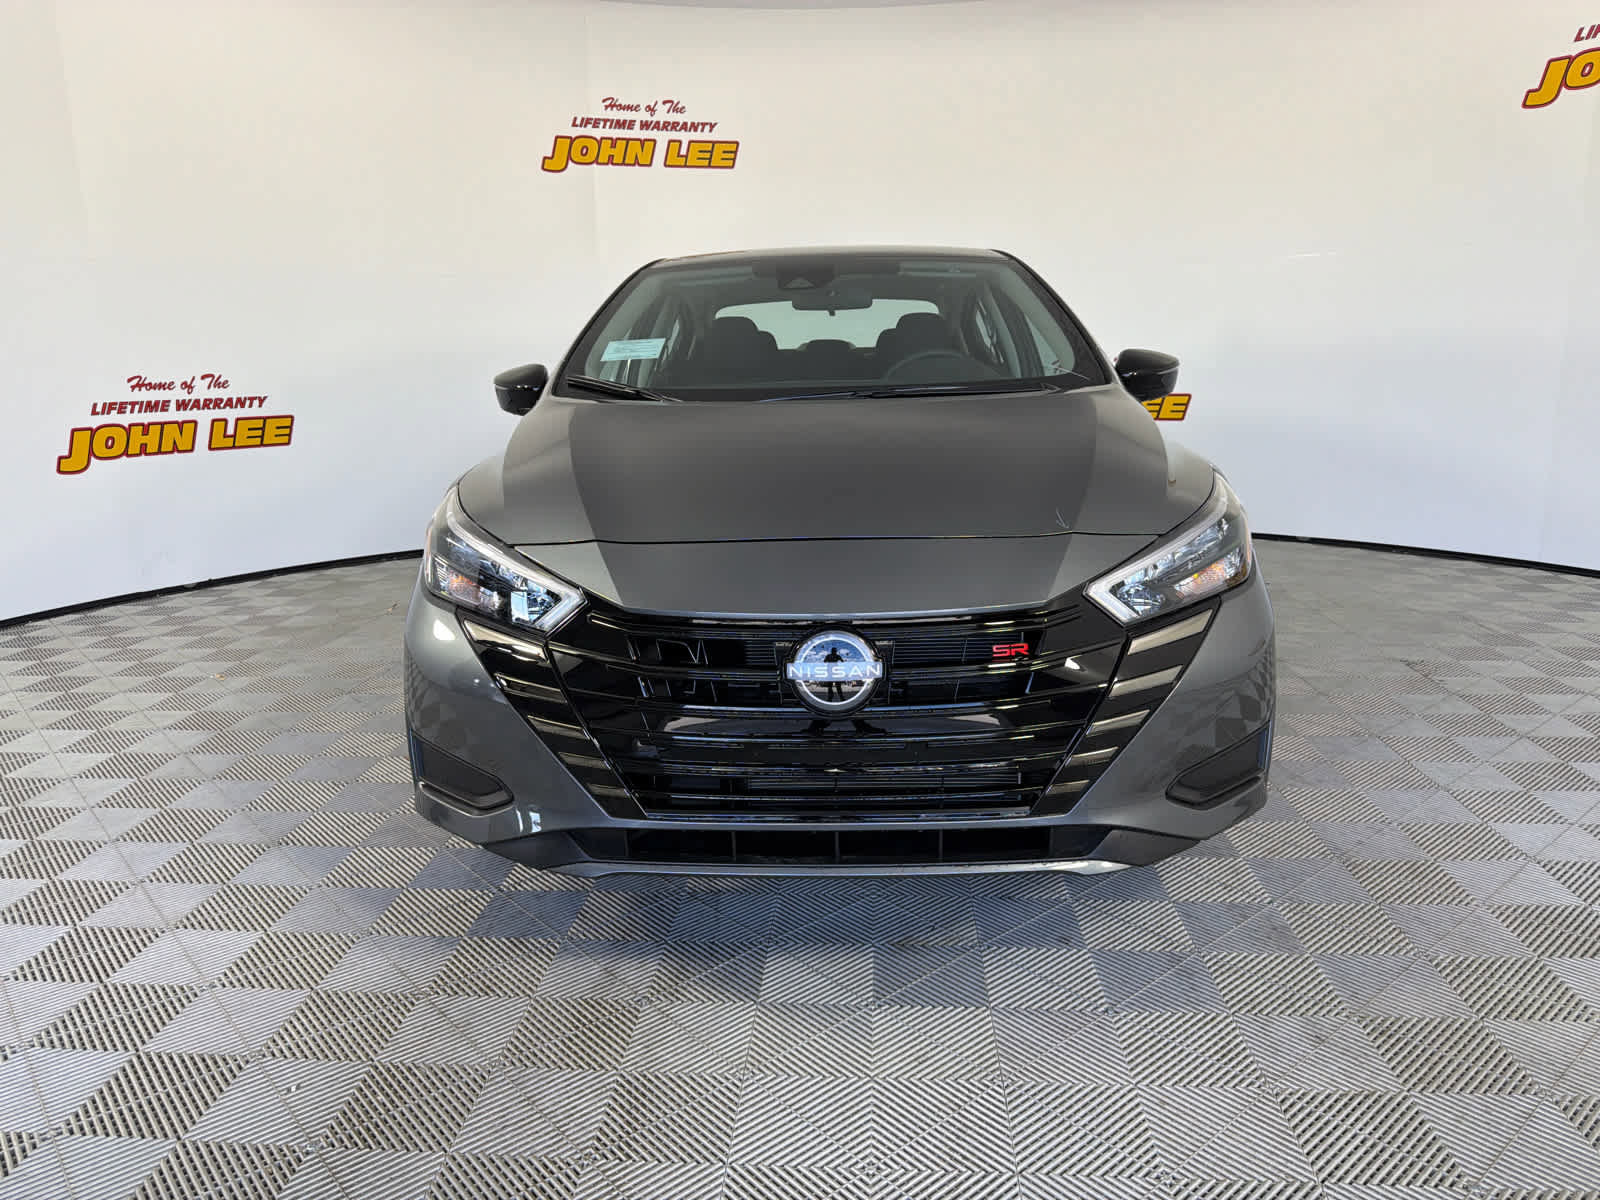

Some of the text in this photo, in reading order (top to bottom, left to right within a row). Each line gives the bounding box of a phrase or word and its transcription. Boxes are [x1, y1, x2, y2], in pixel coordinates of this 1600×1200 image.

[602, 97, 686, 116] Home of The
[571, 116, 718, 133] LIFETIME WARRANTY
[541, 135, 740, 173] JOHN LEE
[127, 373, 230, 394] Home of The
[91, 396, 268, 416] LIFETIME WARRANTY
[56, 415, 294, 475] JOHN LEE
[991, 643, 1029, 657] SR
[788, 662, 881, 678] NISSAN
